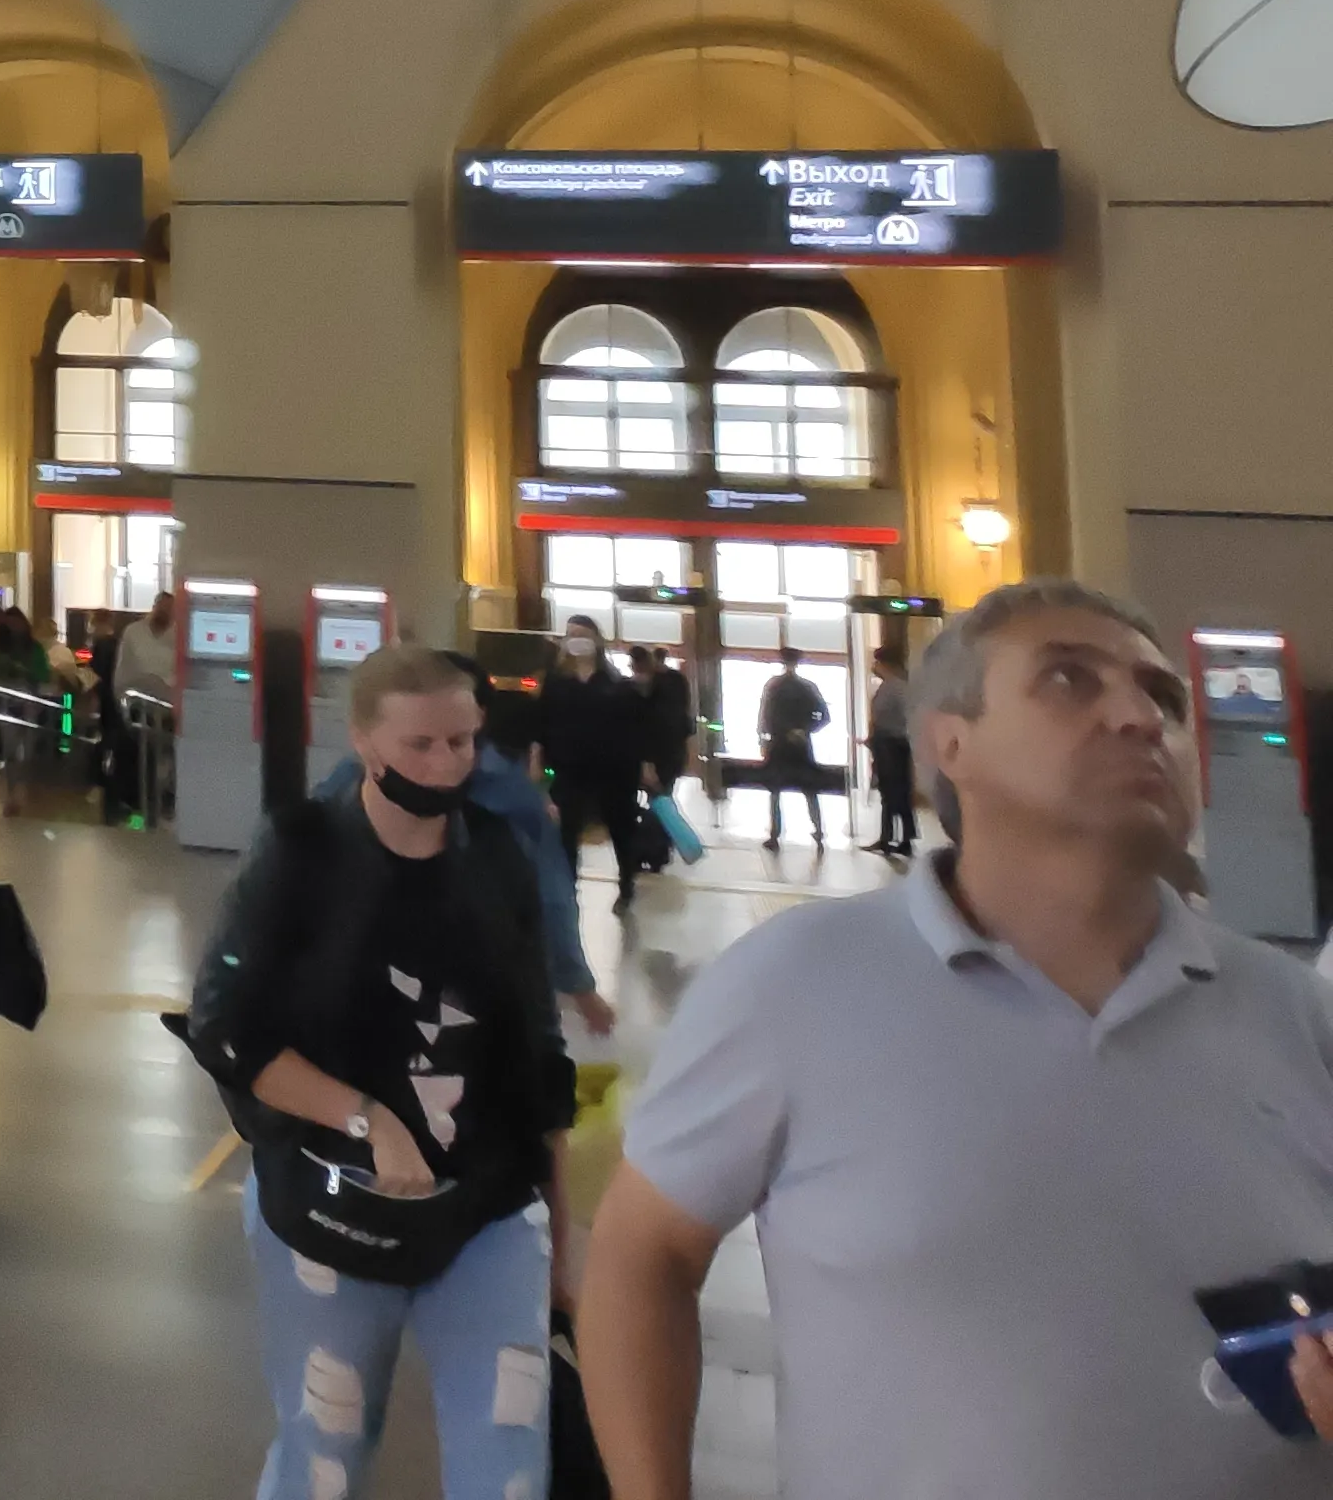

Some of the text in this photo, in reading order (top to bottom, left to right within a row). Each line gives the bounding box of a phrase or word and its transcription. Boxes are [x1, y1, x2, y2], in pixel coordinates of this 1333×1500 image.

[788, 160, 890, 187] Выход
[788, 187, 836, 207] Exit
[788, 213, 846, 231] Метро
